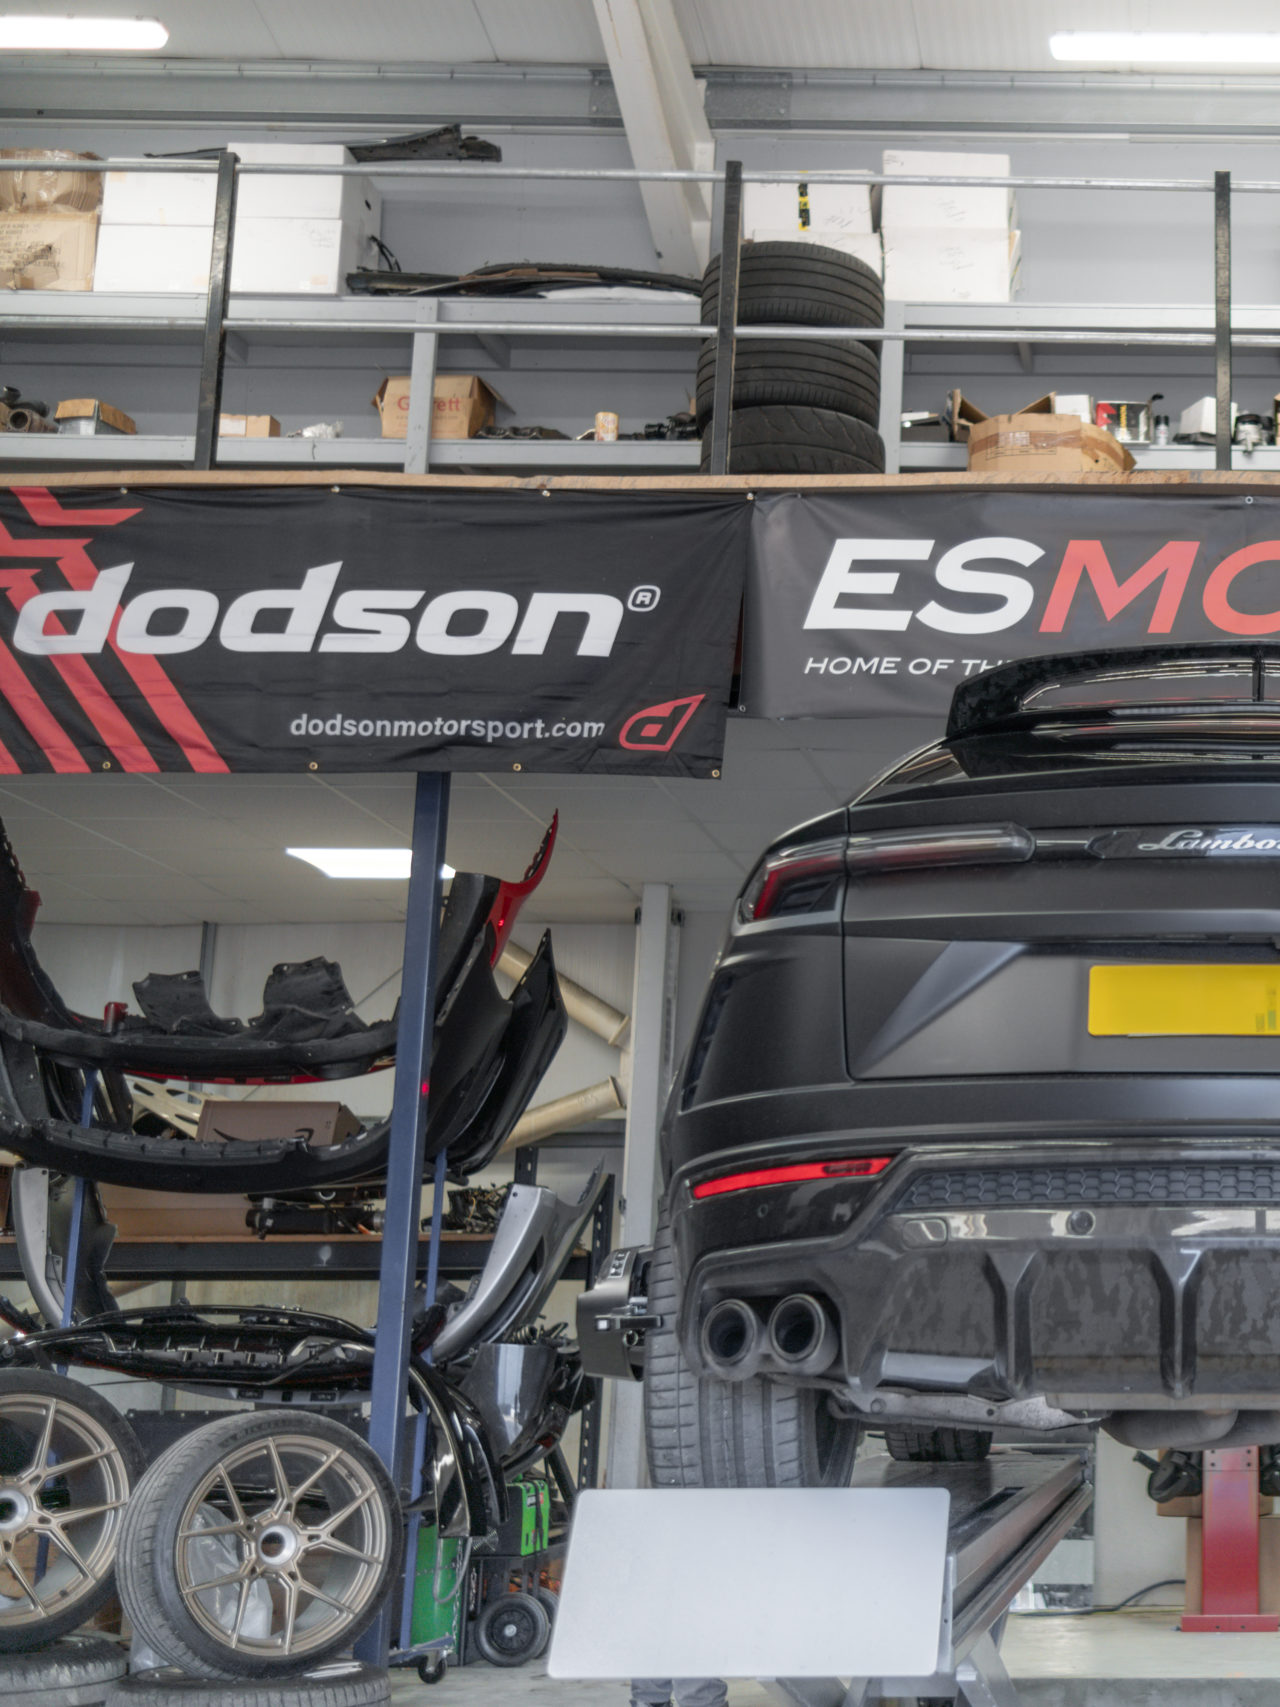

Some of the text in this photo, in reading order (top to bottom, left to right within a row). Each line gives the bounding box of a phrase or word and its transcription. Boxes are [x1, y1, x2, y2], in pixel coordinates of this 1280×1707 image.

[804, 656, 902, 676] HOME
[908, 657, 955, 676] OF
[961, 658, 1014, 677] TH
[290, 713, 606, 743] dodsonmotorsport.com
